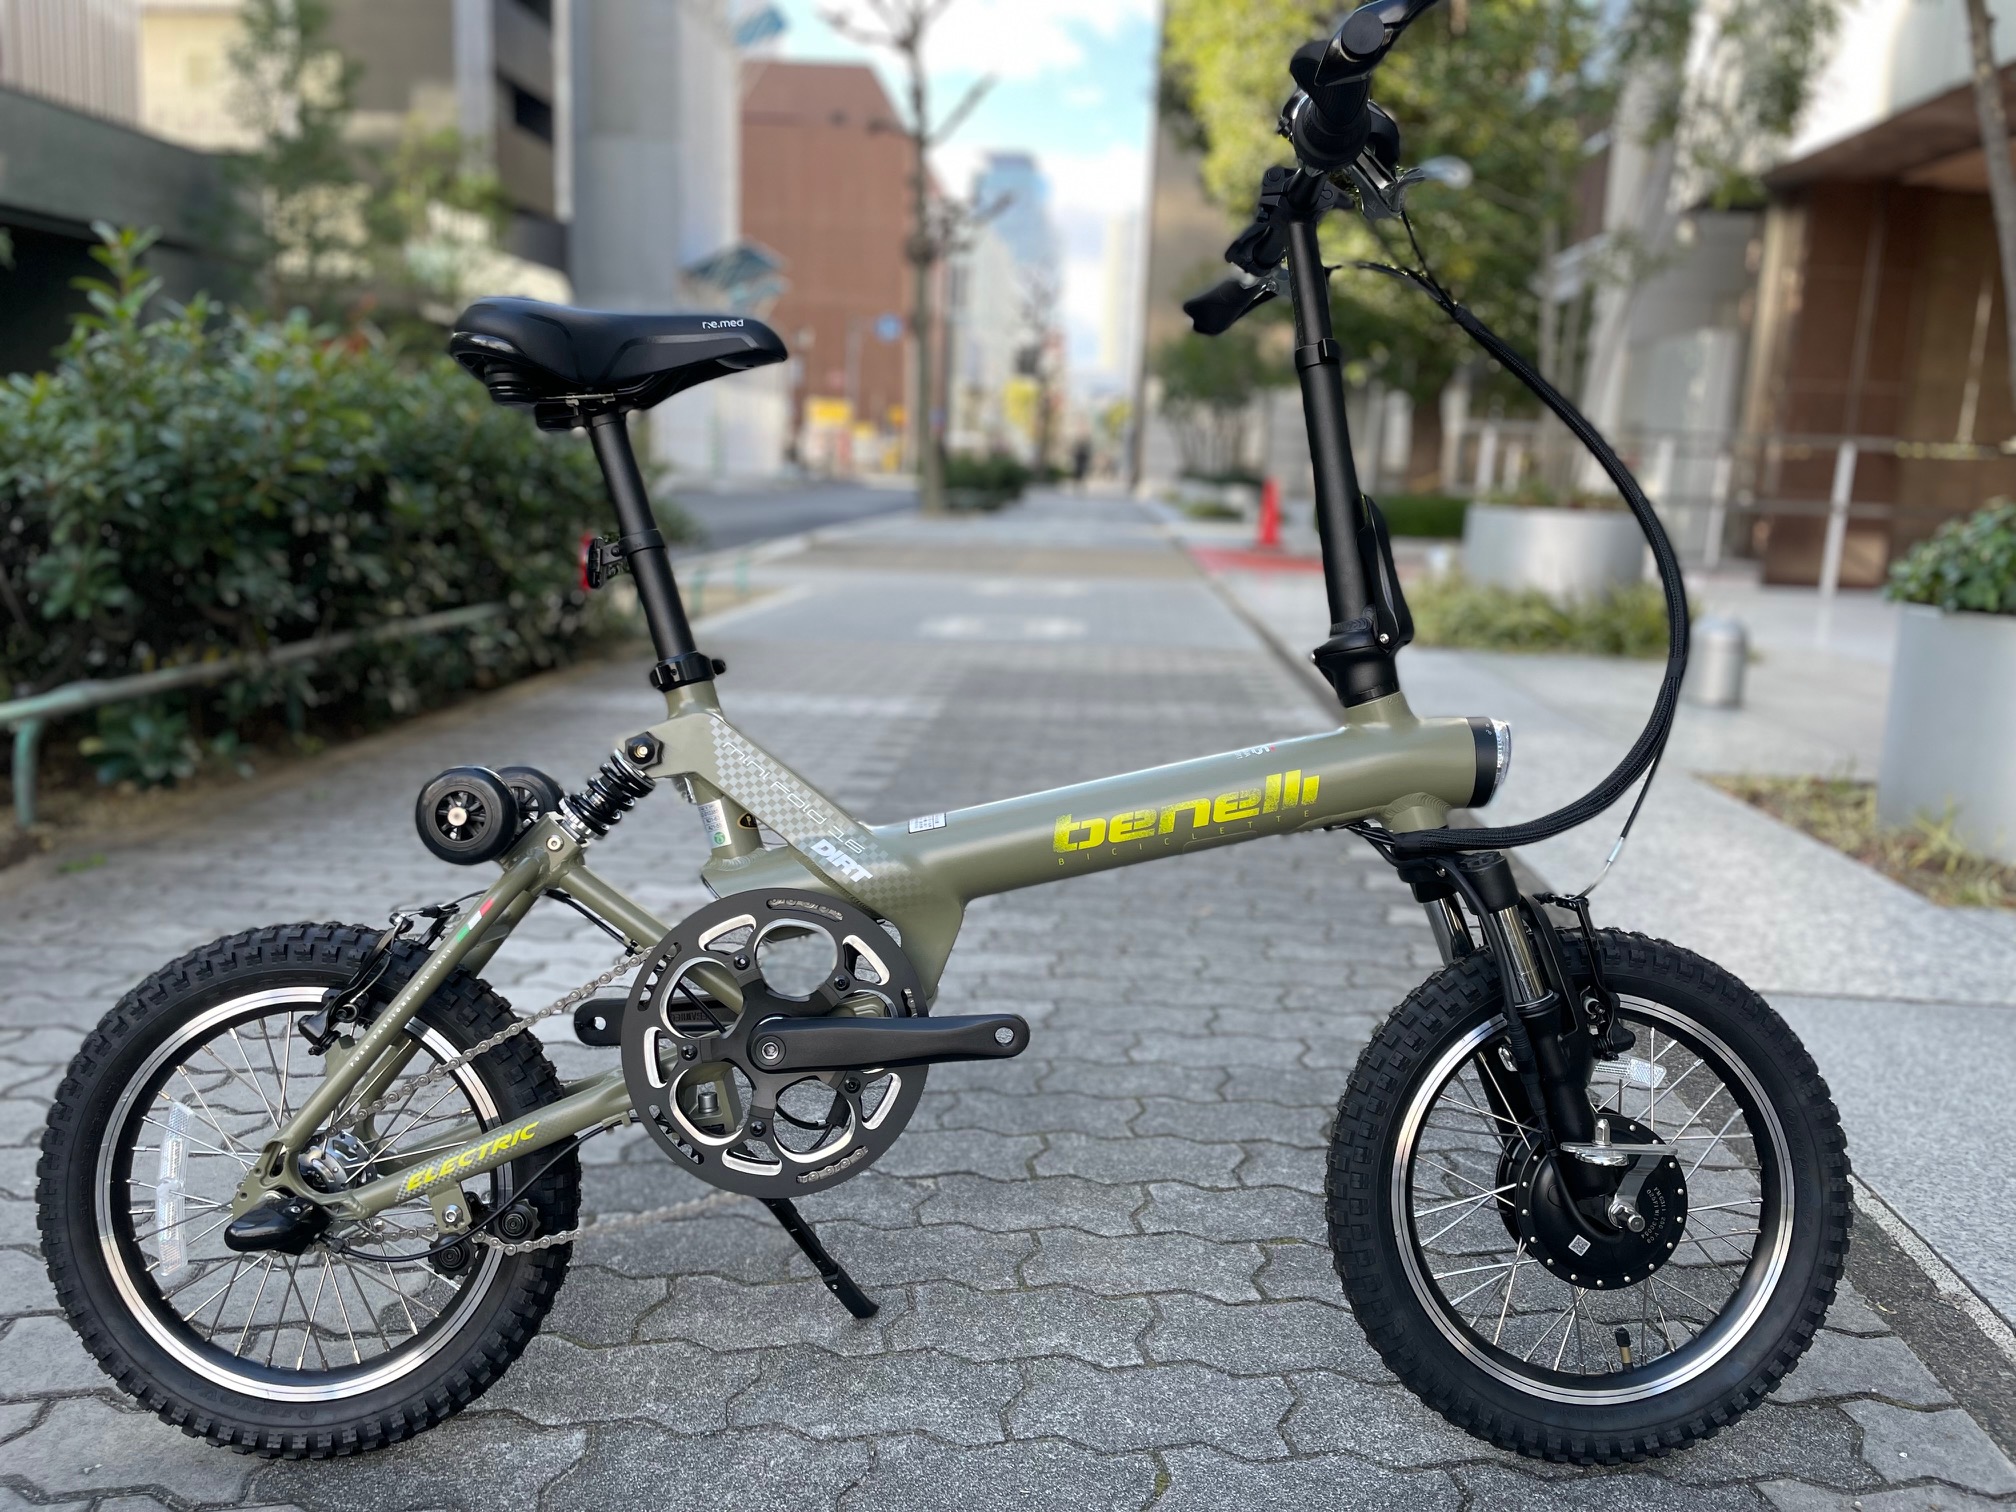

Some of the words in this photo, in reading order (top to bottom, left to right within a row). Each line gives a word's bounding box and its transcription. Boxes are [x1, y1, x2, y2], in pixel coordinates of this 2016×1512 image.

[1053, 769, 1320, 854] benelli
[1058, 809, 1310, 866] BICICLETTE
[810, 838, 874, 883] DIRT
[406, 1120, 540, 1192] ELECTRIC
